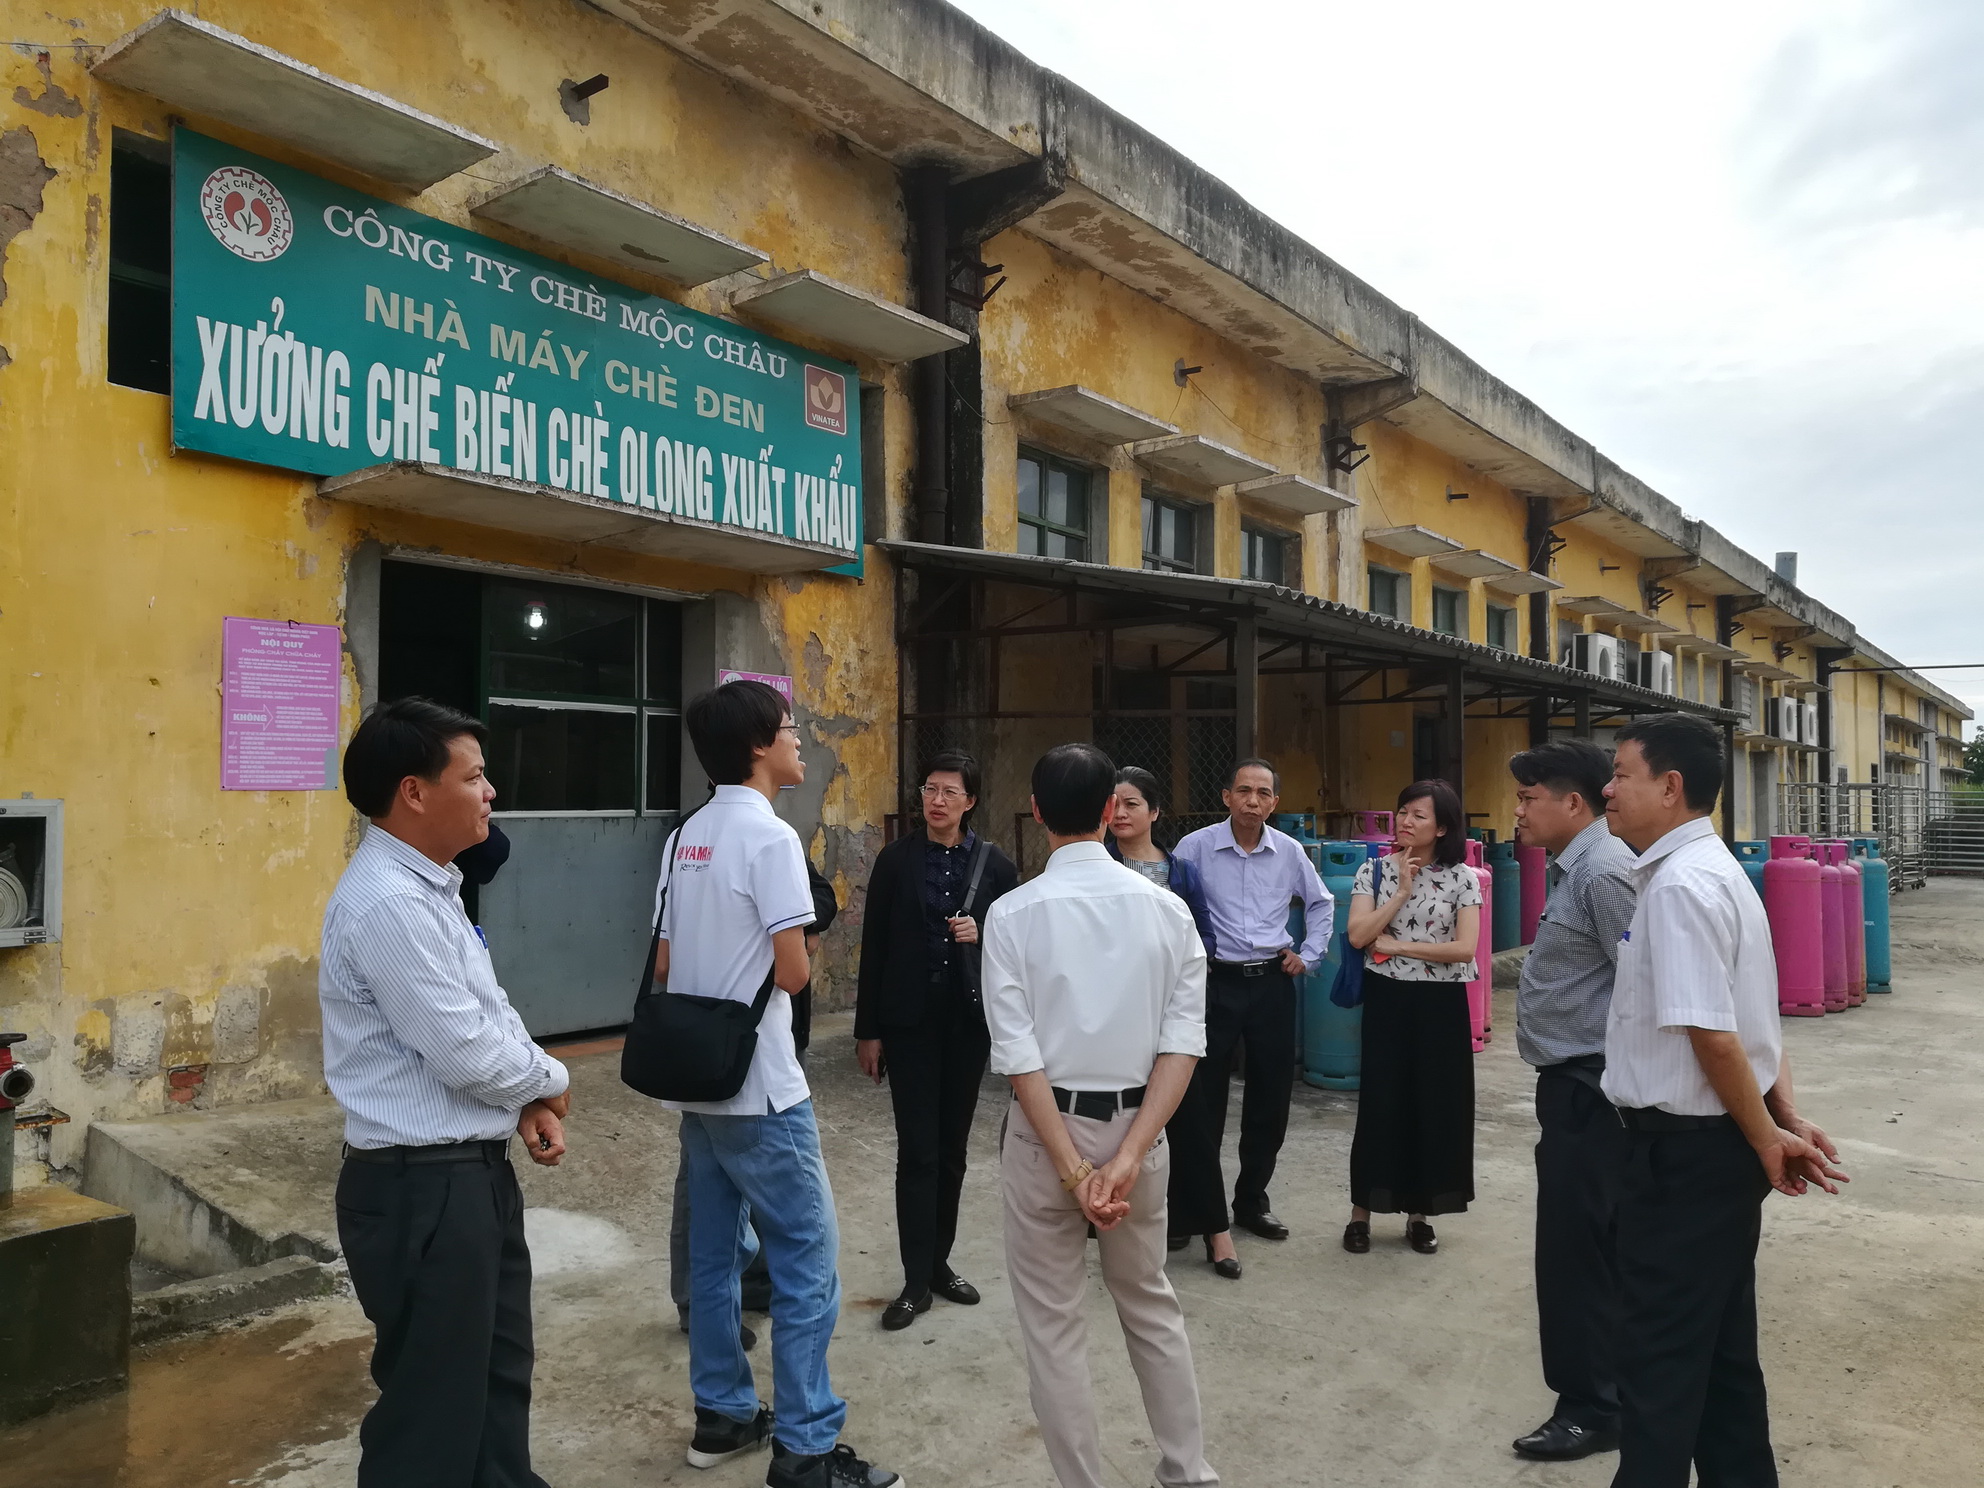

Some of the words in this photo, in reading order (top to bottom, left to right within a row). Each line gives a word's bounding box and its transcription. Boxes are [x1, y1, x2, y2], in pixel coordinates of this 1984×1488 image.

[218, 182, 230, 194] TY
[323, 204, 454, 271] CÔNG
[465, 251, 520, 292] TY
[530, 275, 607, 321] CHÈ
[619, 303, 695, 350] MỘC
[704, 332, 787, 379] CHÂU
[365, 284, 471, 351] NHÀ
[490, 324, 589, 380] MÁY
[605, 358, 678, 409] CHÈ
[695, 385, 765, 432] ĐEN
[194, 296, 350, 449] XƯỞNG
[366, 352, 445, 463] CHẾ
[455, 371, 537, 482] BIẾN
[548, 399, 610, 498] CHÈ
[619, 428, 714, 521] OLONG
[721, 443, 786, 535] XUẤT
[794, 453, 857, 550] KHẨU
[811, 412, 841, 429] VINATEA
[283, 640, 304, 648] QUY
[233, 713, 267, 721] KHÔNG
